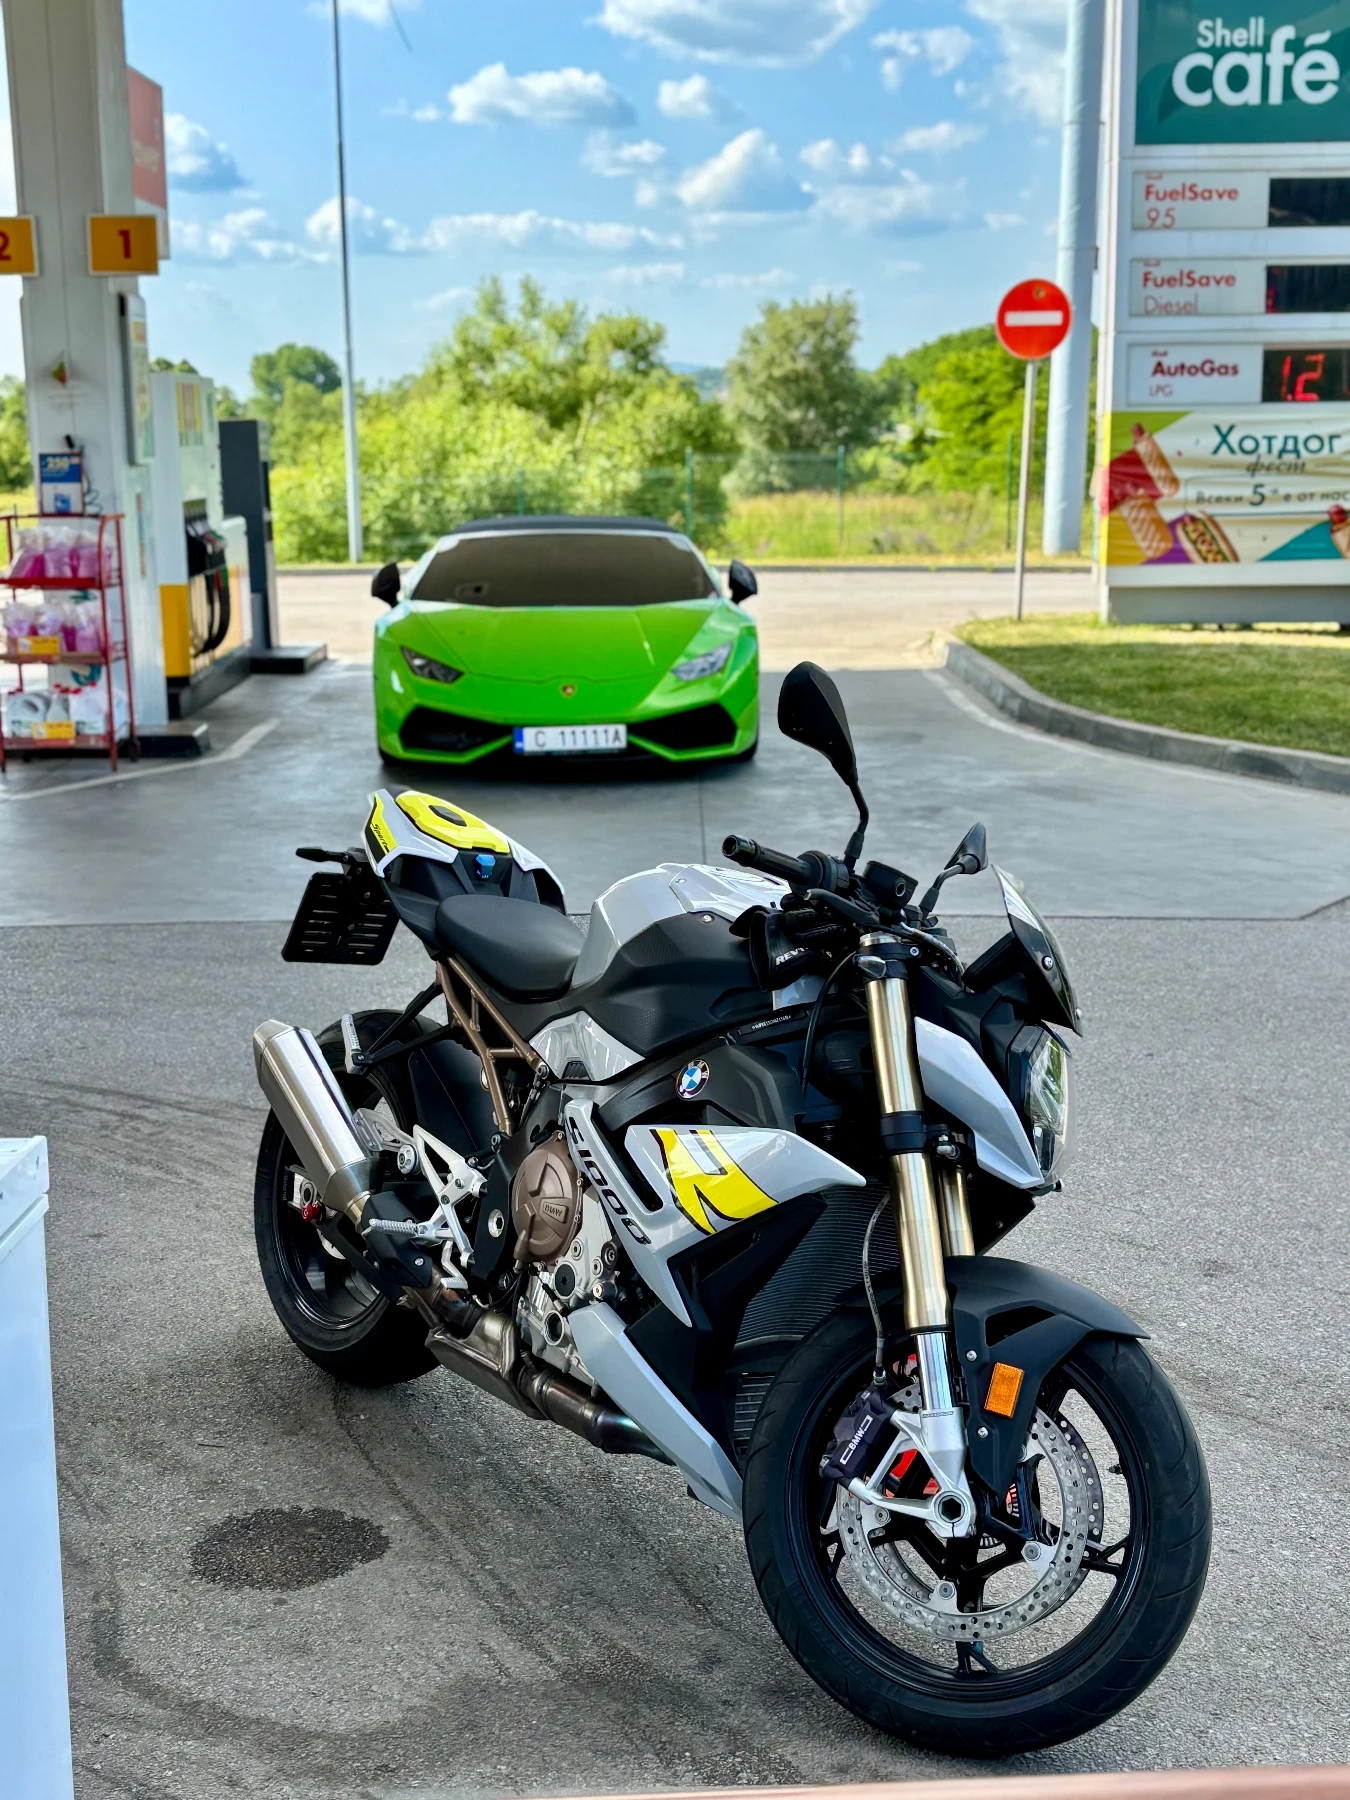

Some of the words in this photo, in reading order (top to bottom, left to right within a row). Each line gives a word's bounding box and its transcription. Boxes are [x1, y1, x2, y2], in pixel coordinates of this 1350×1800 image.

[1197, 16, 1264, 48] Shell
[1172, 25, 1340, 107] café
[1144, 182, 1239, 202] FuelSave
[1146, 207, 1176, 229] 95
[118, 229, 131, 259] 1
[1142, 269, 1236, 289] FuelSave
[1144, 292, 1199, 315] Diesel
[1151, 359, 1239, 377] AutoGas
[1211, 424, 1342, 459] Хотдог
[534, 730, 546, 748] C
[544, 1203, 563, 1217] BMW
[848, 1427, 865, 1451] BMW
